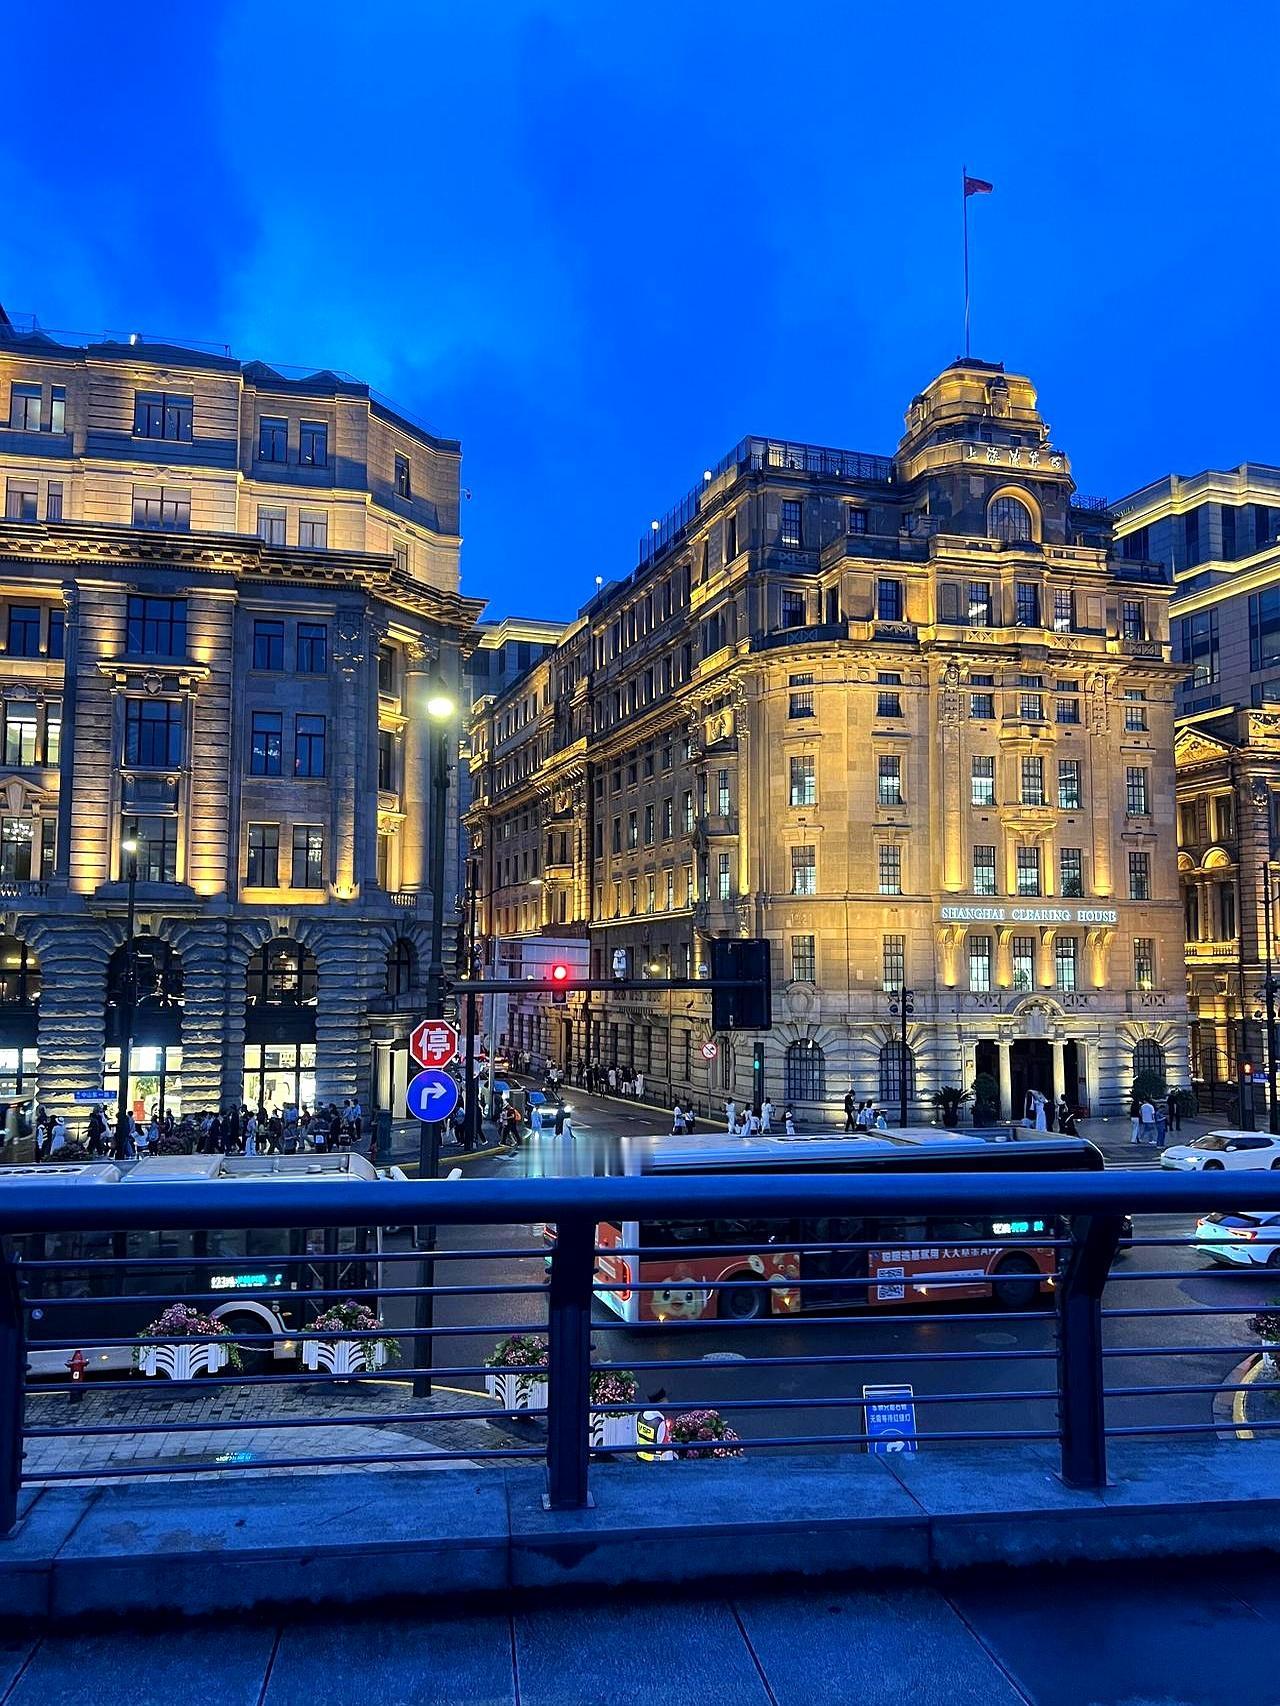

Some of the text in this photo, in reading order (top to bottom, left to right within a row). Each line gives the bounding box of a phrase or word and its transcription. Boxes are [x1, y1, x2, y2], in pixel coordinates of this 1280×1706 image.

[942, 908, 1117, 922] SHANGHAI CLEARING HOUSE
[418, 1028, 450, 1060] 停
